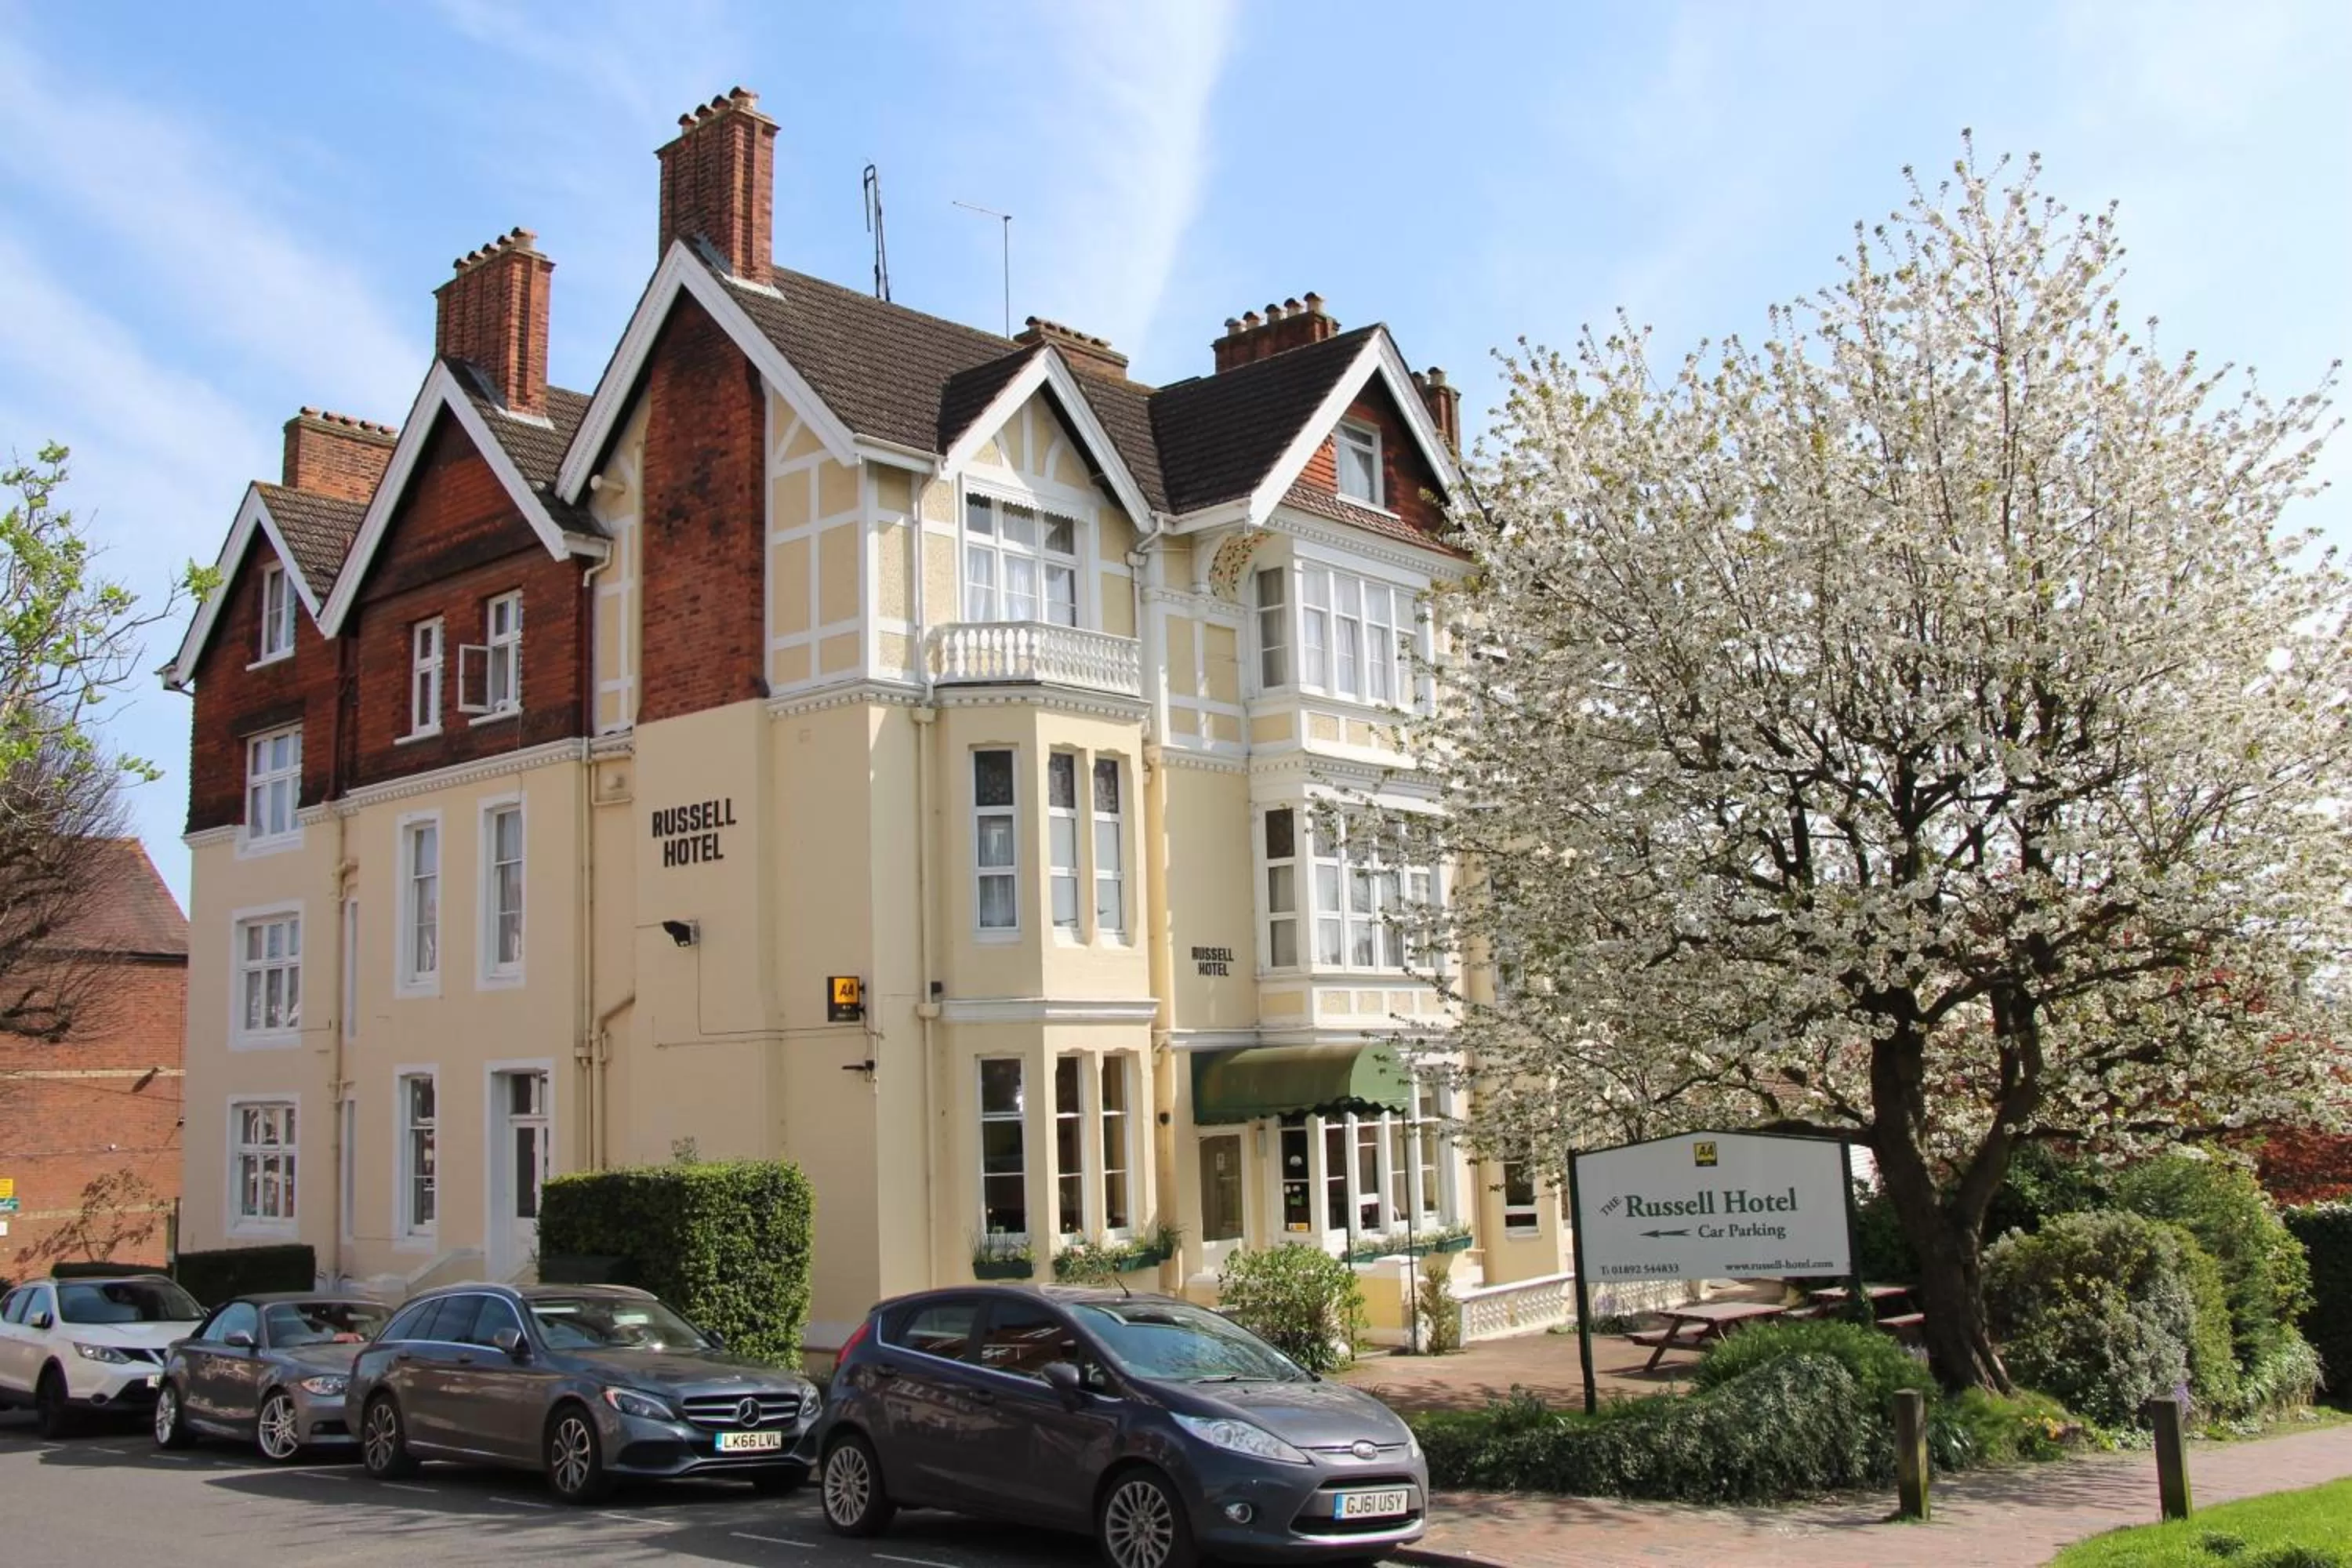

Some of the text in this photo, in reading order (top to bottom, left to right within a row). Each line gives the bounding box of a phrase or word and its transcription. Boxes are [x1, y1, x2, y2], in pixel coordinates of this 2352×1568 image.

[652, 797, 737, 838] RUSSELL
[663, 832, 724, 868] HOTEL
[1191, 946, 1234, 962] RUSSELL
[1198, 961, 1229, 977] HOTEL
[840, 982, 854, 996] AA
[1699, 1144, 1715, 1156] AA
[1600, 1186, 1798, 1218] THE Russell Hotel
[1698, 1221, 1786, 1240] Car Parking
[724, 1432, 779, 1449] LK66 LVL
[1346, 1492, 1403, 1514] GJ61 USY
